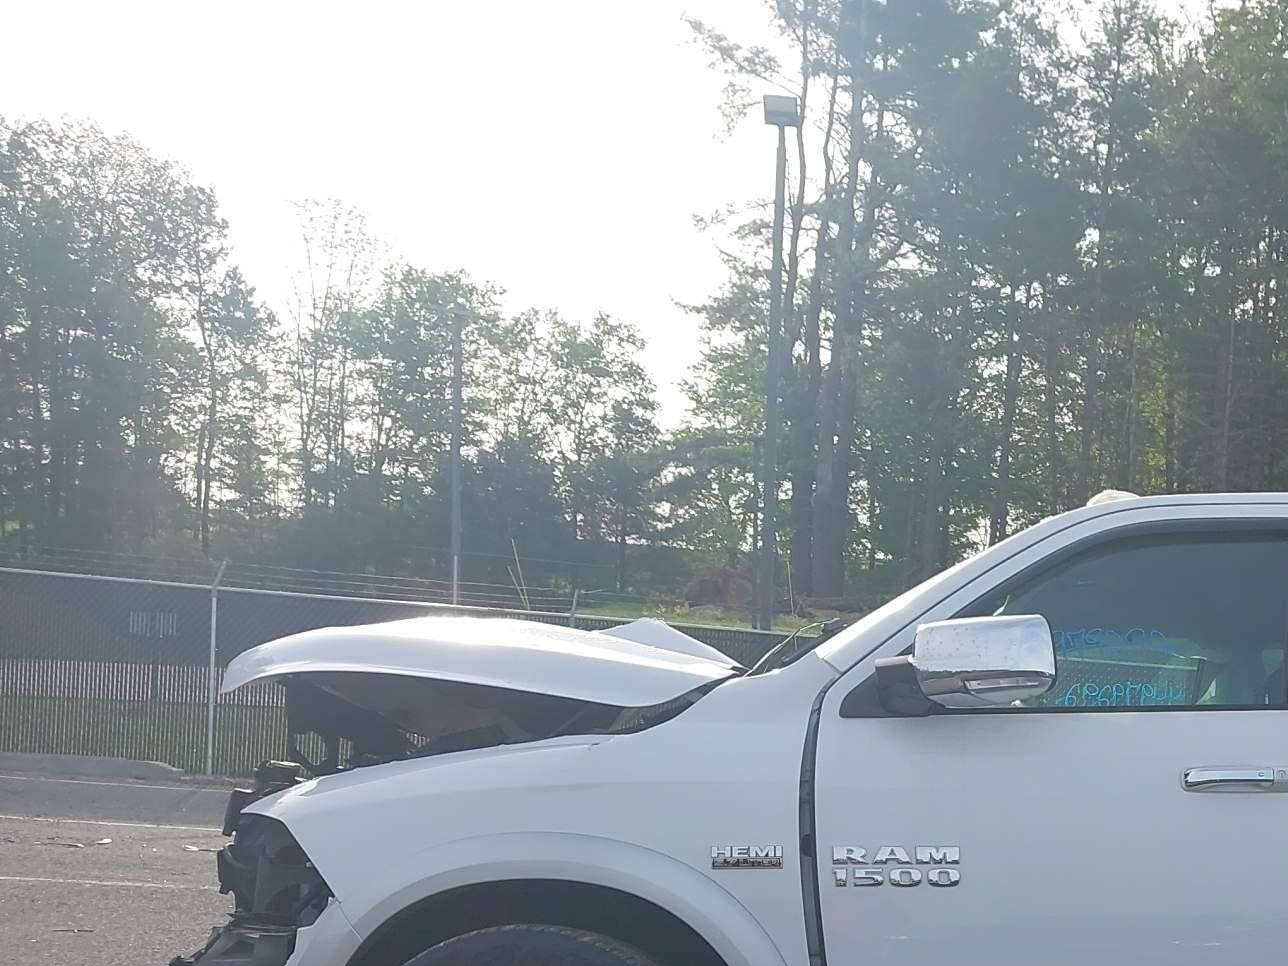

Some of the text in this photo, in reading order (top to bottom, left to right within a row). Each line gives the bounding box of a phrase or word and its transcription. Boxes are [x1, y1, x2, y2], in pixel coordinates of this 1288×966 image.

[711, 845, 783, 858] HEMI
[832, 845, 961, 865] RAM
[832, 867, 961, 888] 1500
